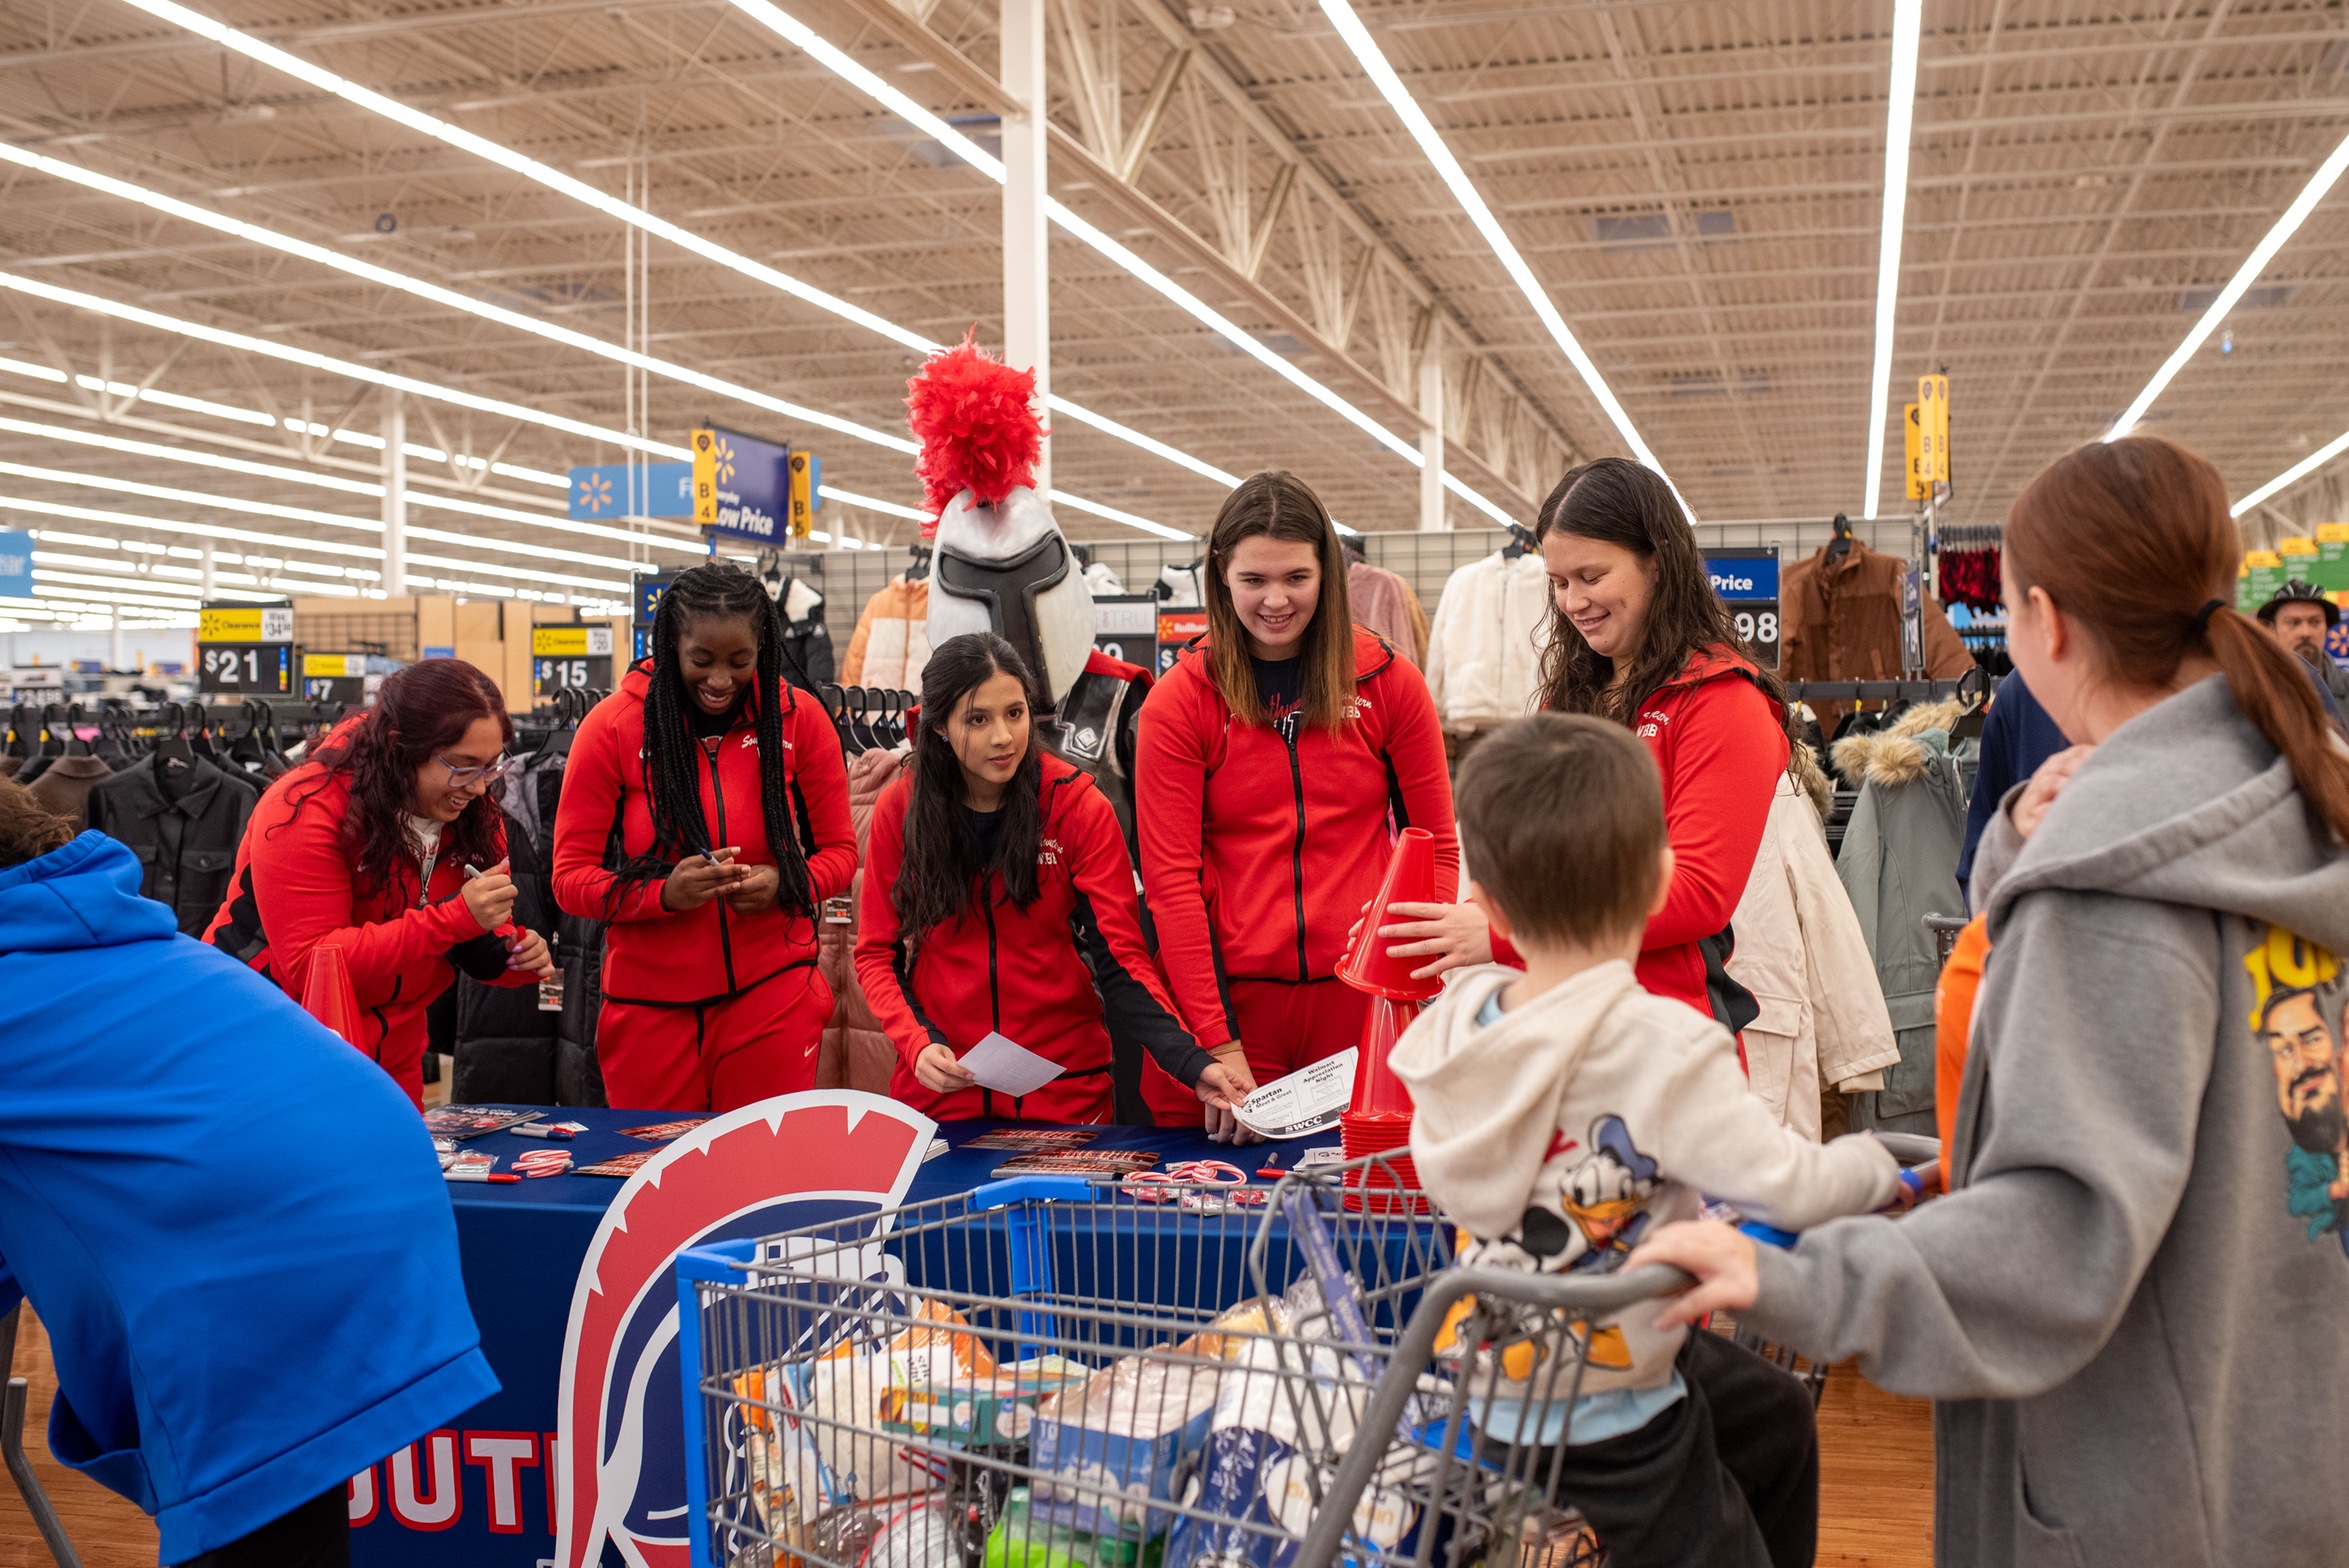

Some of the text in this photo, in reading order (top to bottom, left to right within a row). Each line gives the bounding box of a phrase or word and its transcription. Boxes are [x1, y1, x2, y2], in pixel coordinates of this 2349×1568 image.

[699, 483, 711, 519] B 4
[717, 505, 774, 536] ow Price
[1710, 574, 1753, 590] Price
[221, 620, 260, 630] Clearance
[204, 649, 259, 683] $21
[541, 660, 588, 688] $15
[1303, 1063, 1344, 1083] Appreciation
[1308, 1060, 1336, 1075] Walmart
[1251, 1087, 1283, 1106] Spartan
[1255, 1099, 1271, 1109] Meet
[1276, 1089, 1292, 1100] Greet
[1284, 1115, 1323, 1133] SWCC
